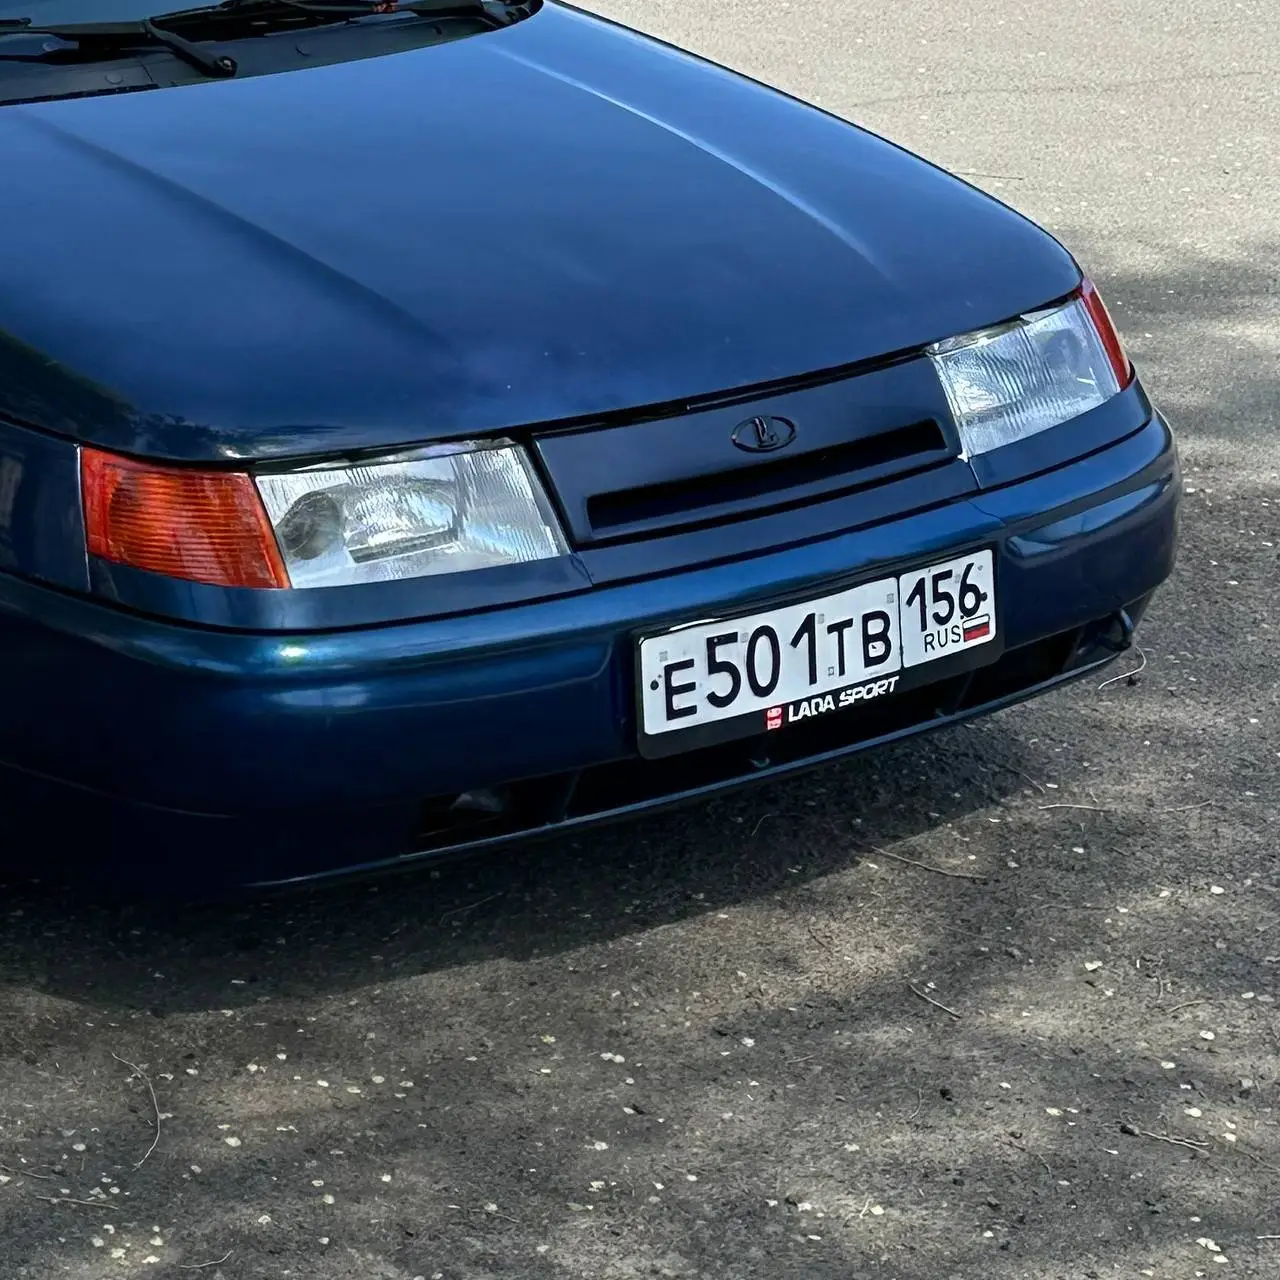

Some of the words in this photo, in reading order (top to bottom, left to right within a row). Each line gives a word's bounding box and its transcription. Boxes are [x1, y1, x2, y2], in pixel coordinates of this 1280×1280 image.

[905, 563, 982, 632] 156
[924, 625, 961, 653] RUS
[788, 694, 835, 723] LADA
[838, 675, 899, 708] SPORT
